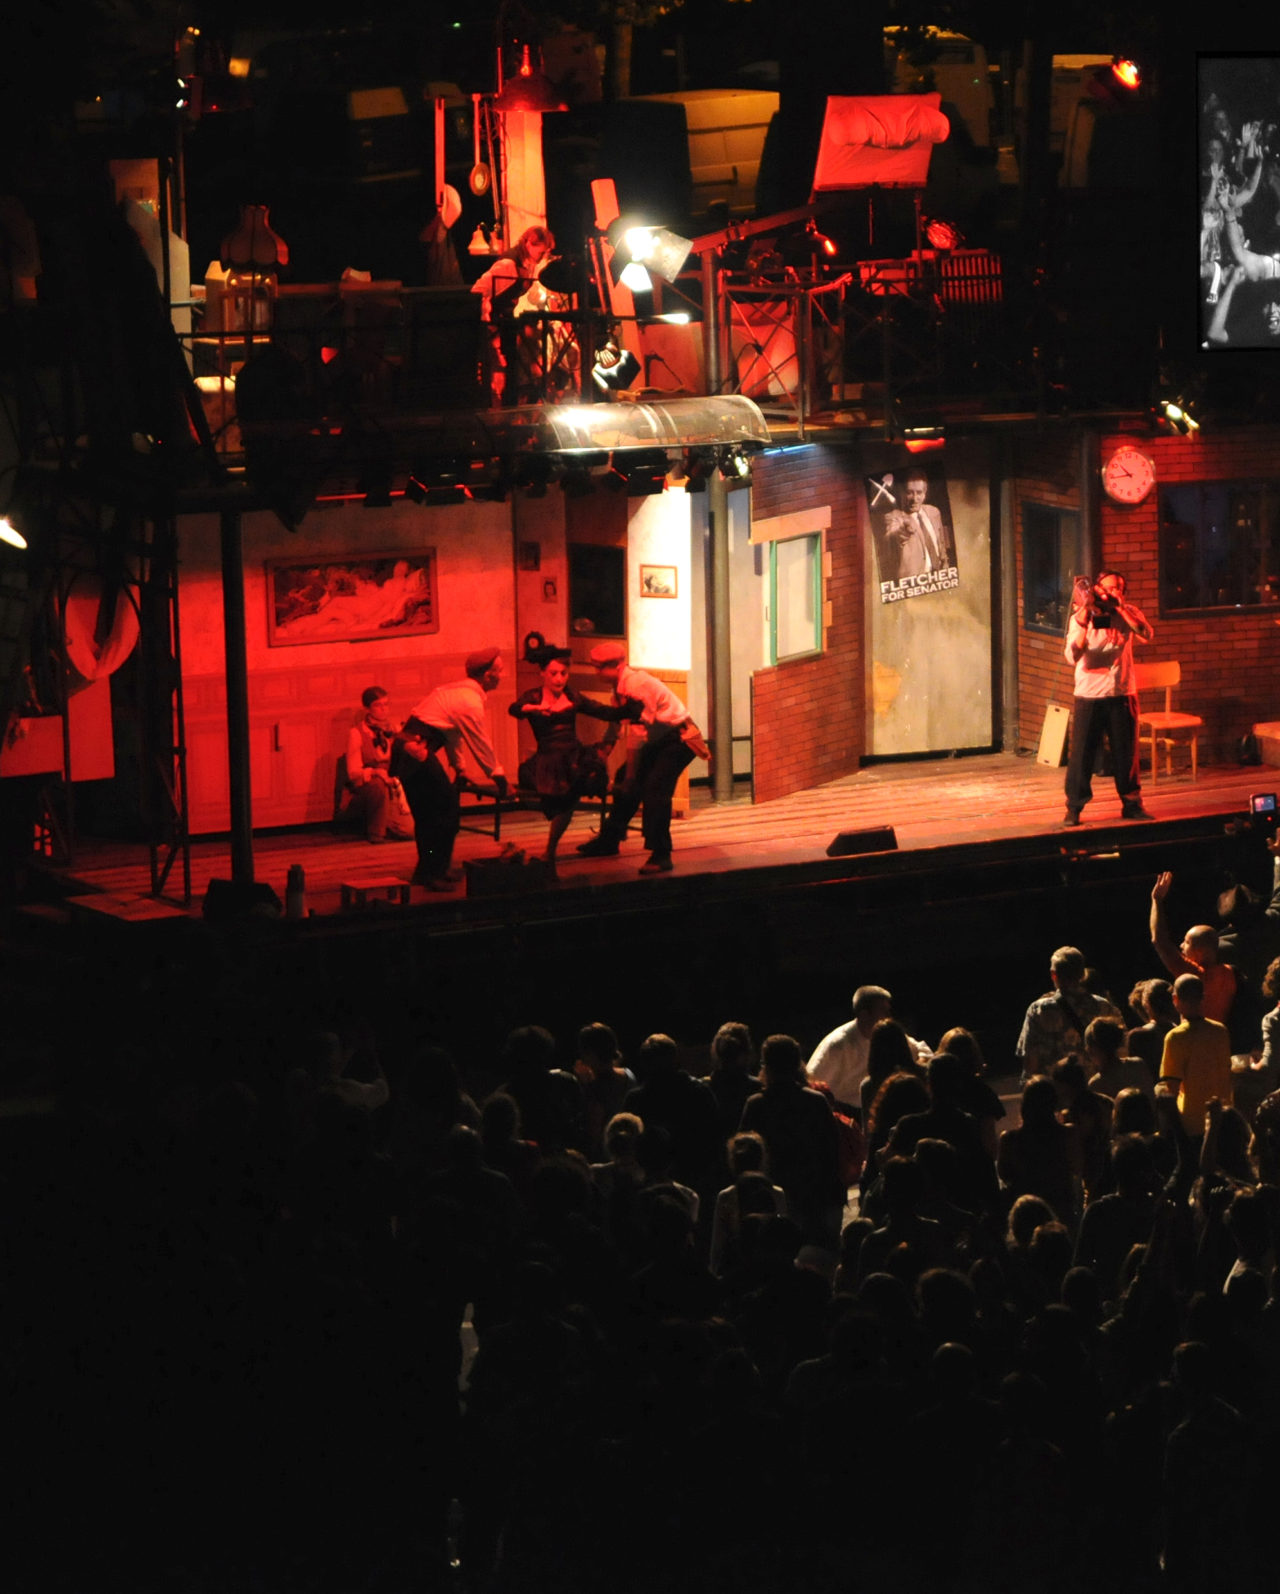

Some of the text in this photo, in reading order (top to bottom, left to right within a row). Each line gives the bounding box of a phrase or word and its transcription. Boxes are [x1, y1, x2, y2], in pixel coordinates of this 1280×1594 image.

[880, 567, 958, 593] FLETCHER
[881, 578, 959, 603] FOR SENATOR
